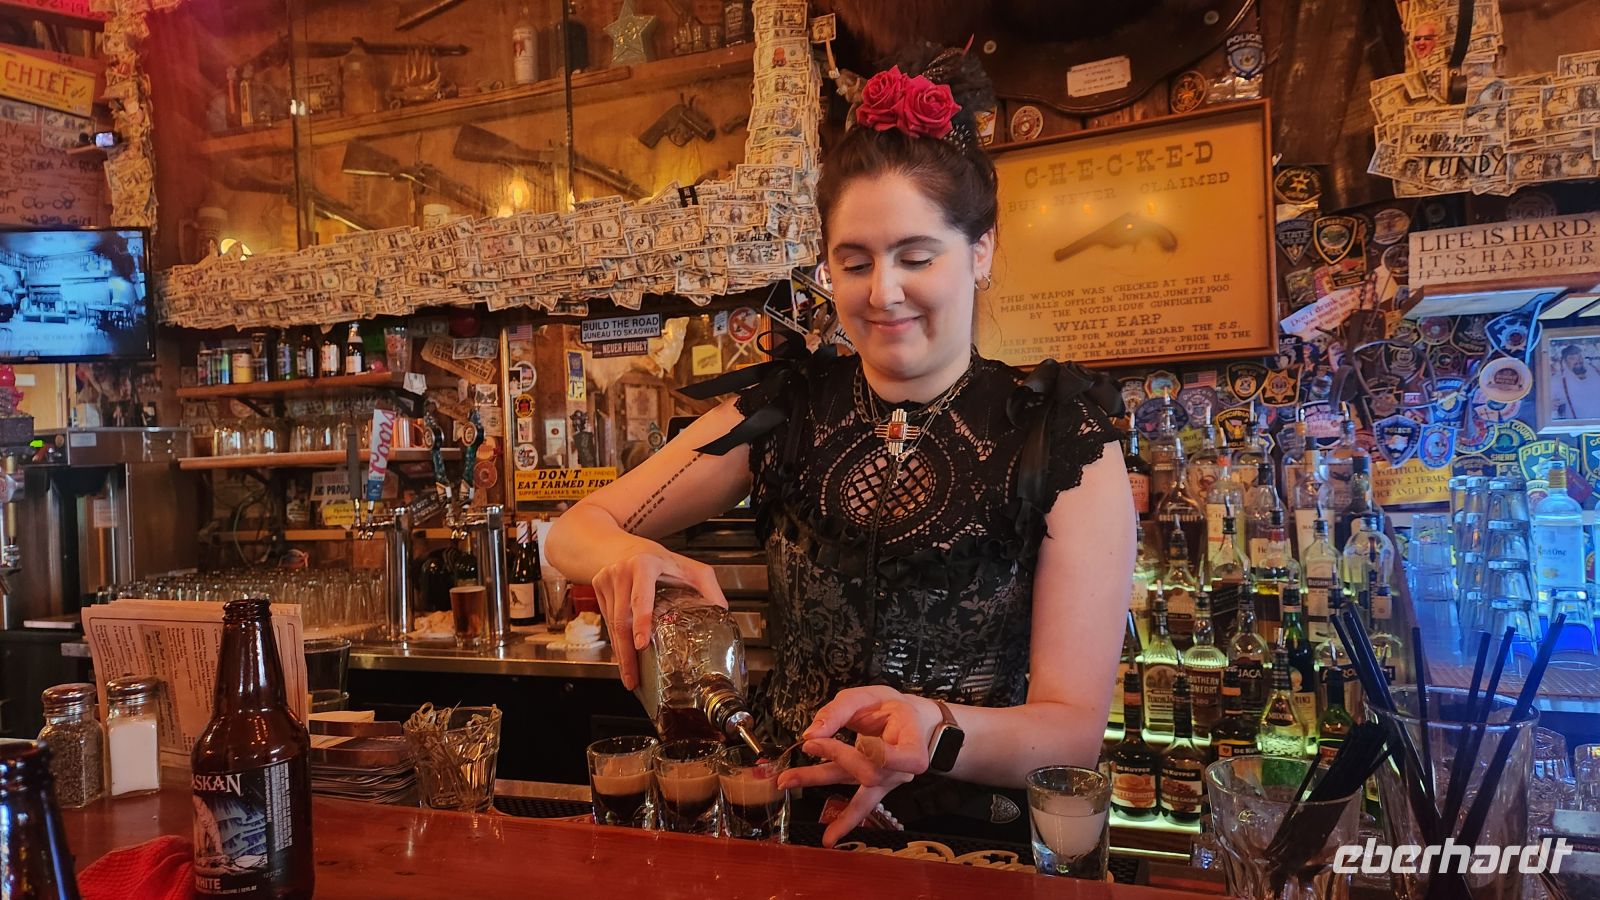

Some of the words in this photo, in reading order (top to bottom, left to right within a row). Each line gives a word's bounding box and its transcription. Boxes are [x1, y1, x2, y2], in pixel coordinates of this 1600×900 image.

[1226, 33, 1263, 47] POLICE
[4, 60, 76, 96] CHIEF
[1053, 187, 1117, 207] NEVER
[1140, 171, 1230, 195] CLAIMED
[1420, 231, 1474, 252] LIFE
[1483, 227, 1505, 245] IS
[1418, 252, 1466, 269] IT'S
[1482, 240, 1594, 263] HARDER
[1418, 270, 1431, 280] IF
[1441, 264, 1512, 277] YOU'RE
[1000, 294, 1025, 304] THIS
[1030, 289, 1074, 300] WEAPON
[1082, 287, 1105, 295] WAS
[1113, 281, 1159, 293] CHECKED
[1162, 279, 1177, 288] AT
[1184, 276, 1205, 285] THE
[1065, 297, 1096, 307] OFFICE
[1102, 295, 1113, 304] IN
[1163, 288, 1189, 297] JUNE
[1207, 284, 1230, 293] 1900
[1030, 311, 1042, 320] BY
[1051, 309, 1071, 318] THE
[1079, 302, 1144, 315] NOTORIOUS
[1150, 296, 1213, 308] GUNFIGHTER
[1315, 297, 1338, 313] drink
[582, 321, 609, 331] BUILD
[612, 319, 630, 329] THE
[633, 317, 659, 327] ROAD
[1053, 318, 1108, 332] WYATT
[1117, 313, 1162, 327] EARP
[583, 331, 611, 340] JUNEAU
[624, 326, 659, 336] SKAGWAY
[1033, 334, 1077, 344] DEPARTED
[1082, 332, 1100, 340] FOR
[1106, 329, 1135, 339] NOME
[1143, 326, 1184, 336] ABOARD
[1192, 323, 1213, 332] THE
[1115, 339, 1127, 347] ON
[1132, 337, 1156, 346] JUNE
[1180, 334, 1209, 342] PRIOR
[1215, 332, 1228, 340] TO
[1231, 330, 1252, 338] THE
[603, 342, 623, 354] NEVER
[623, 341, 648, 352] FORGET
[1174, 343, 1210, 352] OFFICE
[369, 410, 397, 475] Coors
[1522, 441, 1569, 460] POLIE
[538, 469, 582, 480] DON'T
[517, 481, 537, 490] EAT
[540, 480, 585, 489] FARMED
[588, 480, 613, 488] FISH
[1396, 488, 1415, 496] AND
[1189, 675, 1220, 685] OUTHERN
[1191, 684, 1218, 695] OMFORT
[1169, 769, 1196, 777] KUYPER
